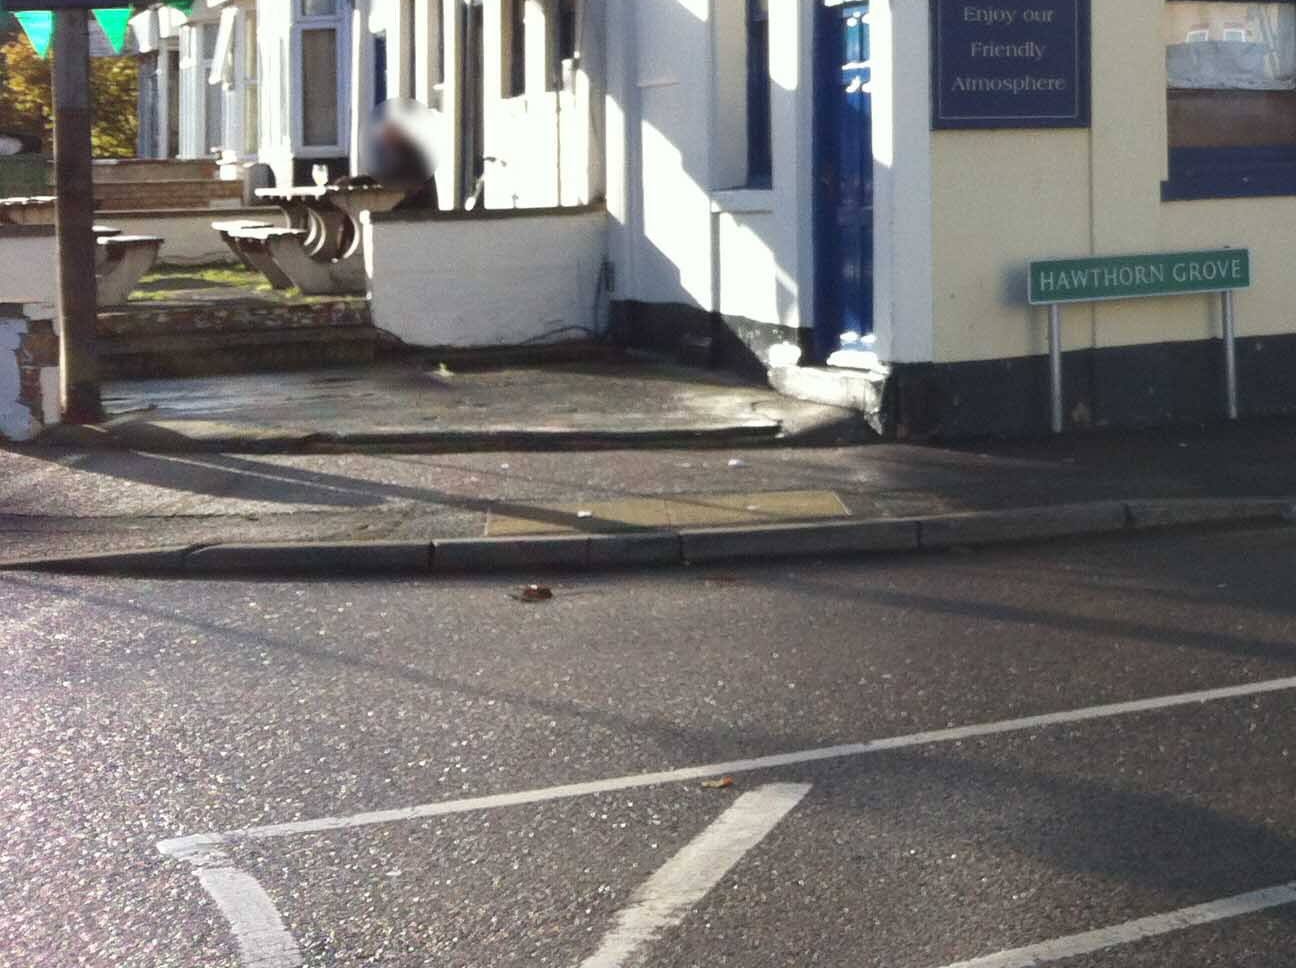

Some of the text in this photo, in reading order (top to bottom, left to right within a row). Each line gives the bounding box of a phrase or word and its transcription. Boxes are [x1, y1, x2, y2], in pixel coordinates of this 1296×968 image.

[964, 6, 1055, 24] Enjoy our
[970, 40, 1045, 61] Friendly
[951, 75, 1066, 95] Atmosphere
[1039, 259, 1241, 291] HAWTHORN GROVE
